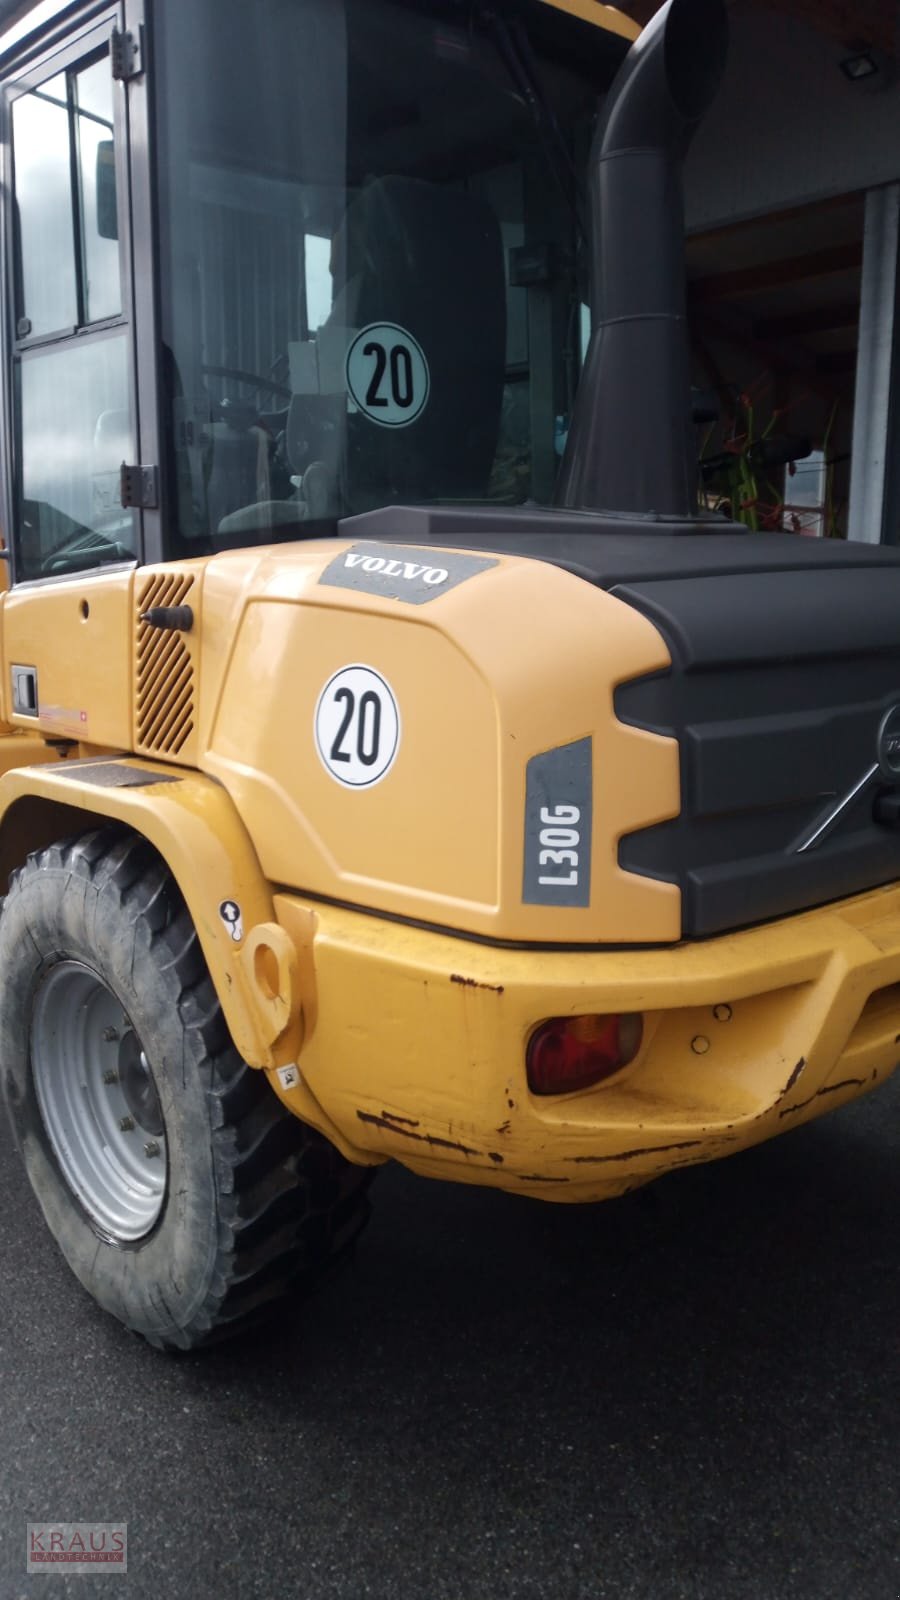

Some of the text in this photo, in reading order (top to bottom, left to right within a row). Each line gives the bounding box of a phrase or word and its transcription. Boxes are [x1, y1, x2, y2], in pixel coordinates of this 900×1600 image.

[362, 341, 414, 408] 20
[343, 553, 449, 584] VOLVO
[331, 686, 381, 767] 20
[538, 803, 581, 888] L30G
